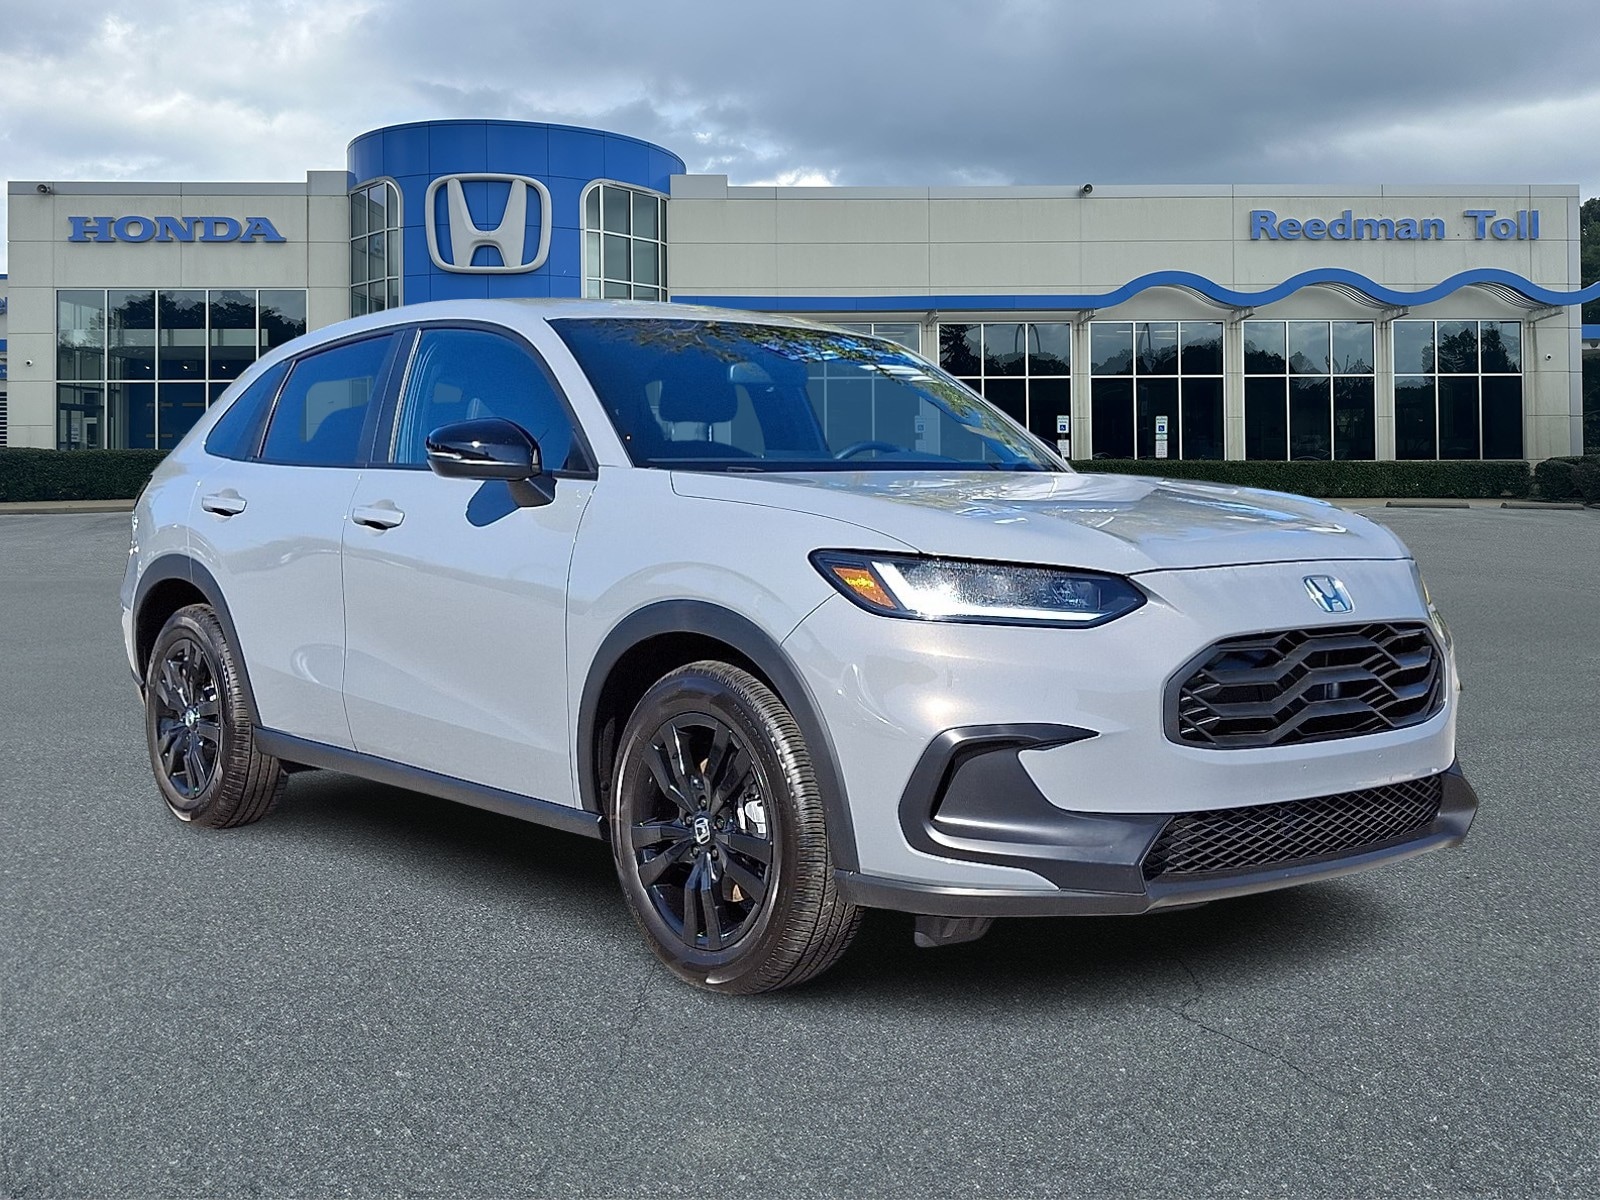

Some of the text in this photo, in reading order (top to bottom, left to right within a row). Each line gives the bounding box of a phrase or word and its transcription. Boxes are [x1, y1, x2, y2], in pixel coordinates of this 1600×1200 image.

[68, 215, 287, 243] HONDA
[1250, 210, 1540, 241] Reedman Toll
